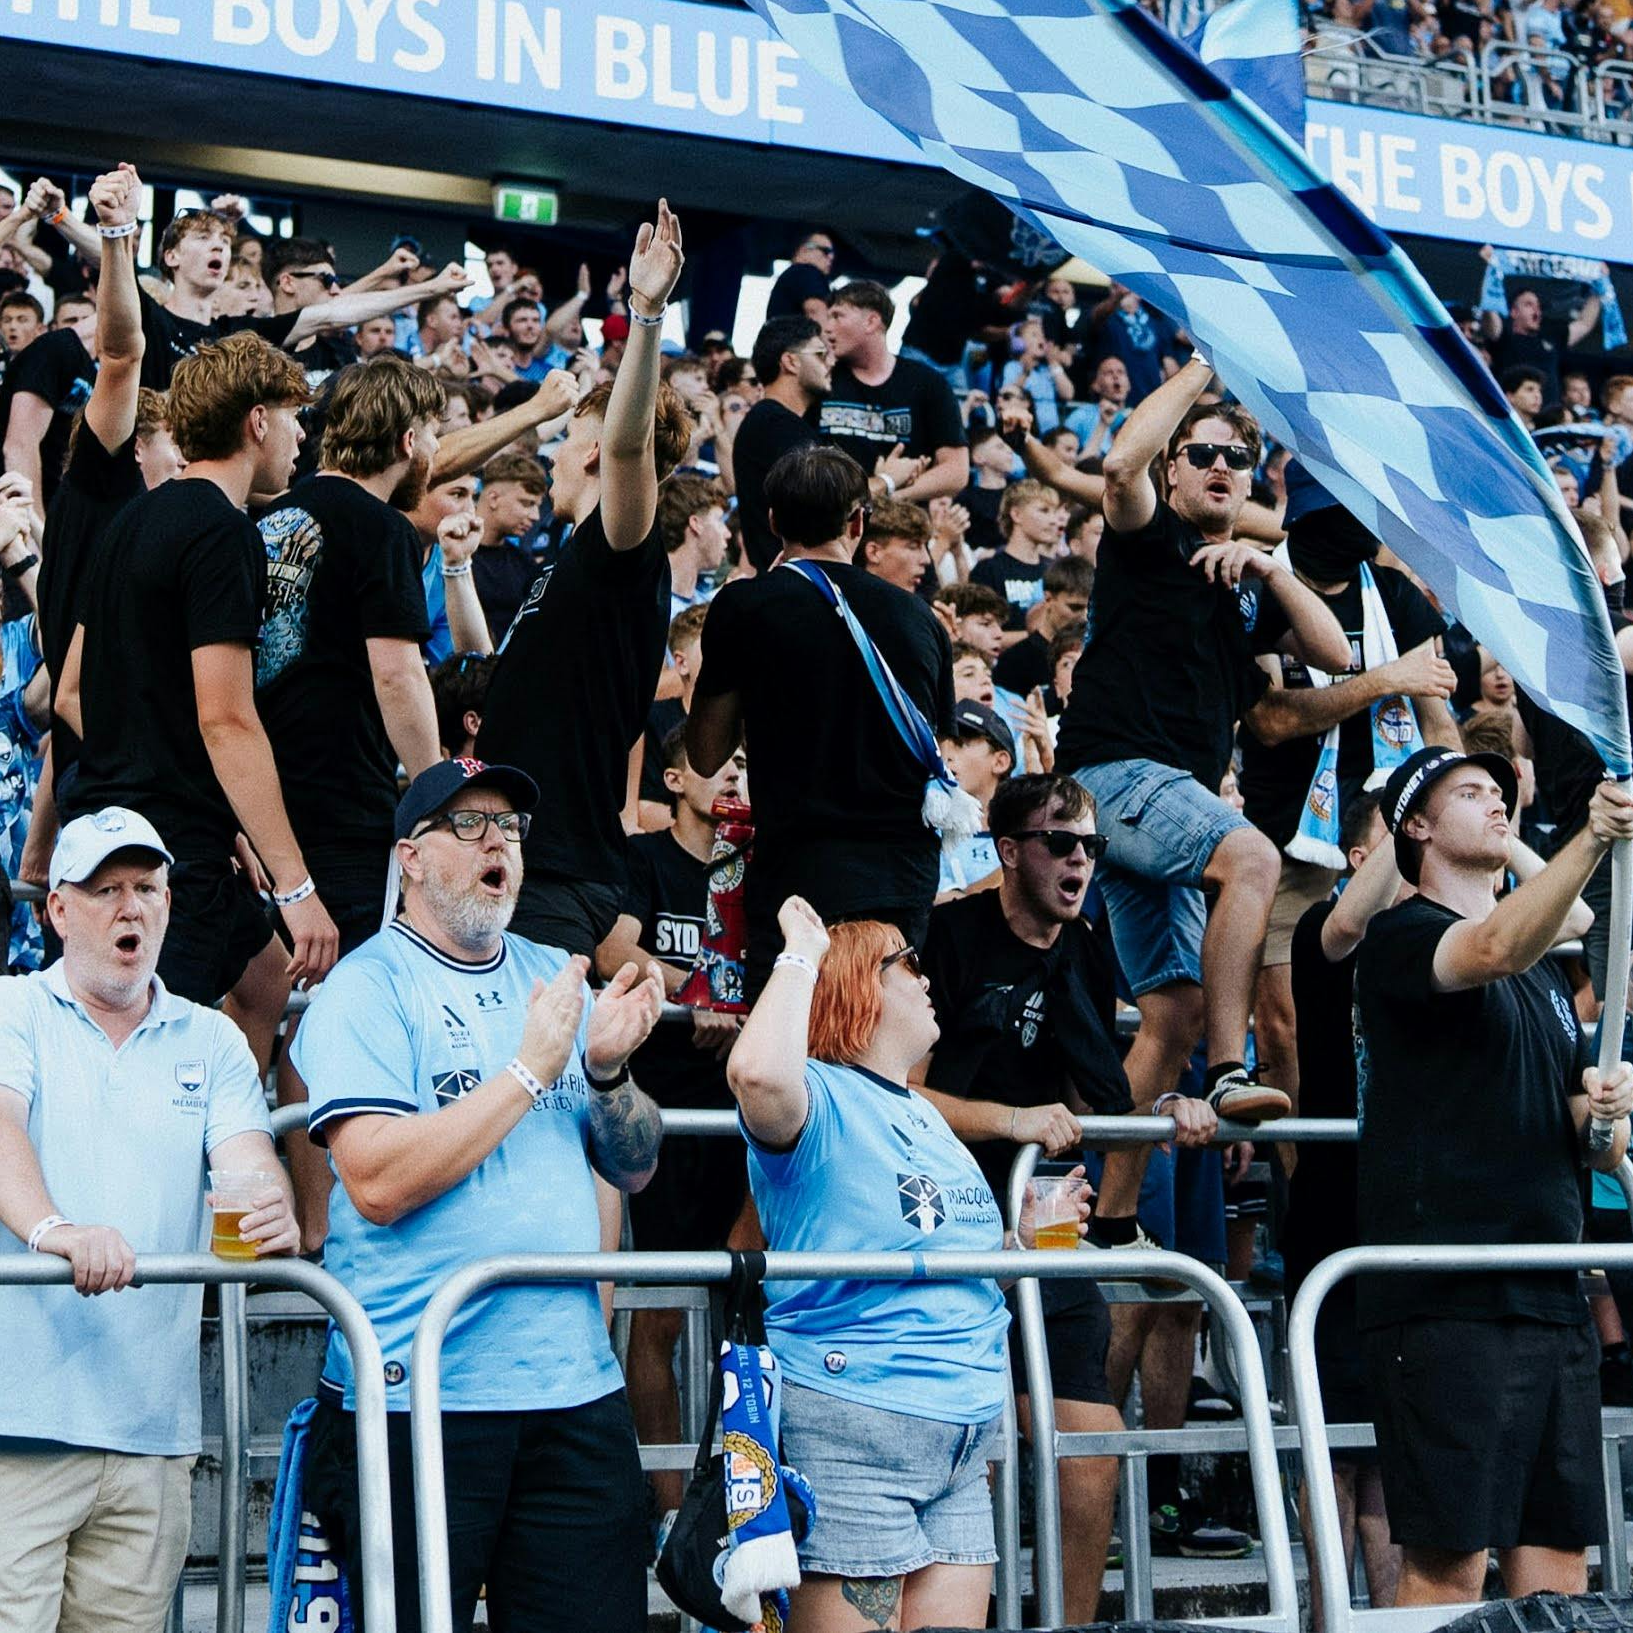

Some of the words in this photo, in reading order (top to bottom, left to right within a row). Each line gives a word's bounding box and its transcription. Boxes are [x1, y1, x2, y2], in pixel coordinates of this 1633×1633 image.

[595, 14, 804, 124] BLUE
[1439, 143, 1613, 240] BOYS
[655, 919, 700, 955] SYD
[741, 1377, 753, 1391] 12
